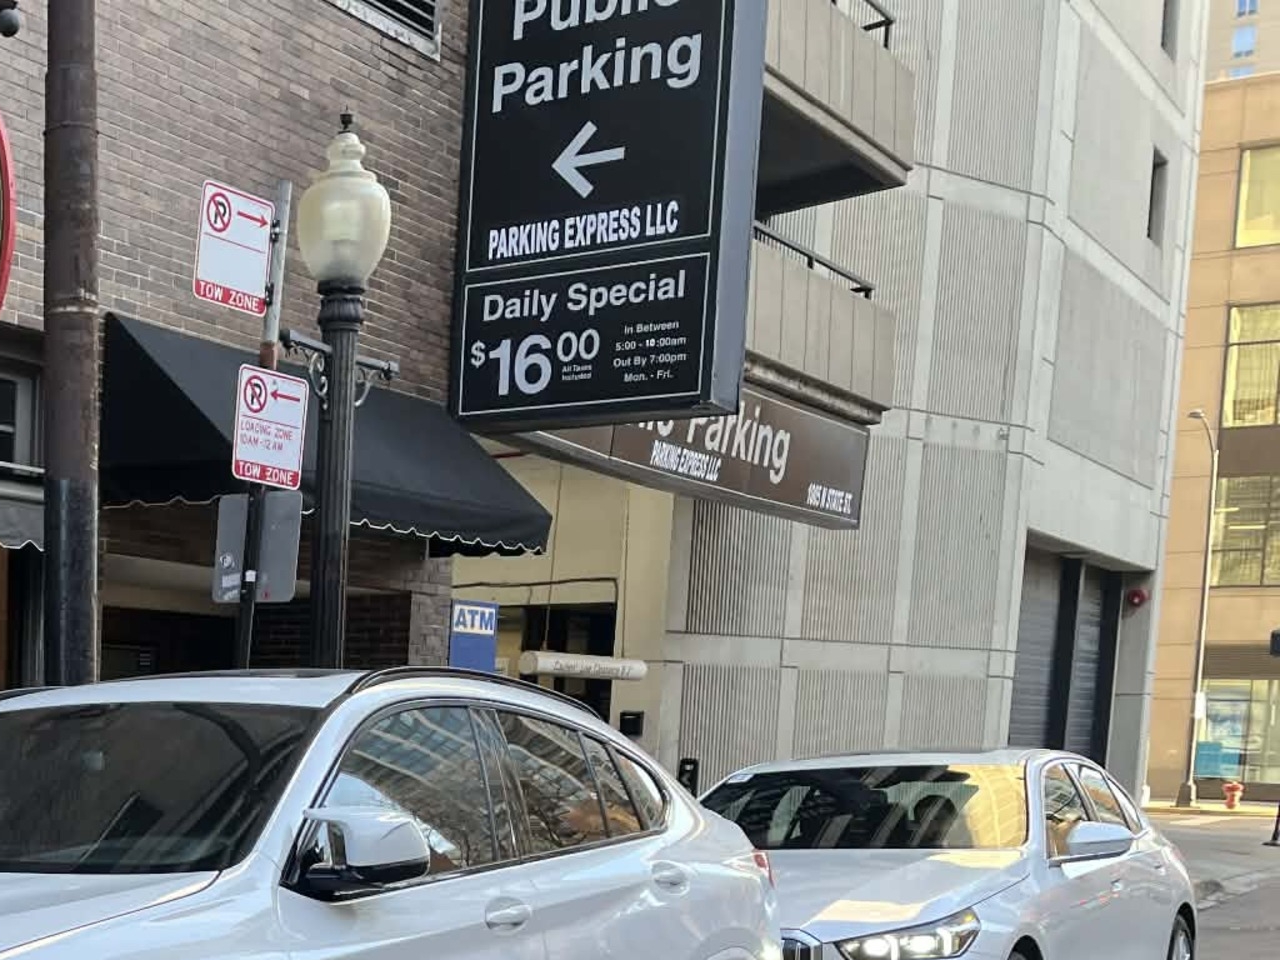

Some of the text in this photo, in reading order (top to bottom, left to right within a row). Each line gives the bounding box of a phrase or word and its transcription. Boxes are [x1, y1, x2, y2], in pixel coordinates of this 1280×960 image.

[492, 32, 702, 113] Parking
[488, 200, 680, 261] PARKING EXPRESS LLC
[199, 281, 260, 312] TOW ZONE
[482, 269, 687, 322] Daily Special
[624, 320, 680, 336] In Between
[615, 340, 637, 352] 5:00
[613, 352, 687, 368] Out By 7:00pm
[240, 420, 294, 441] LOADING ZONE
[239, 462, 294, 486] TOW ZONE
[454, 608, 494, 631] ATM
